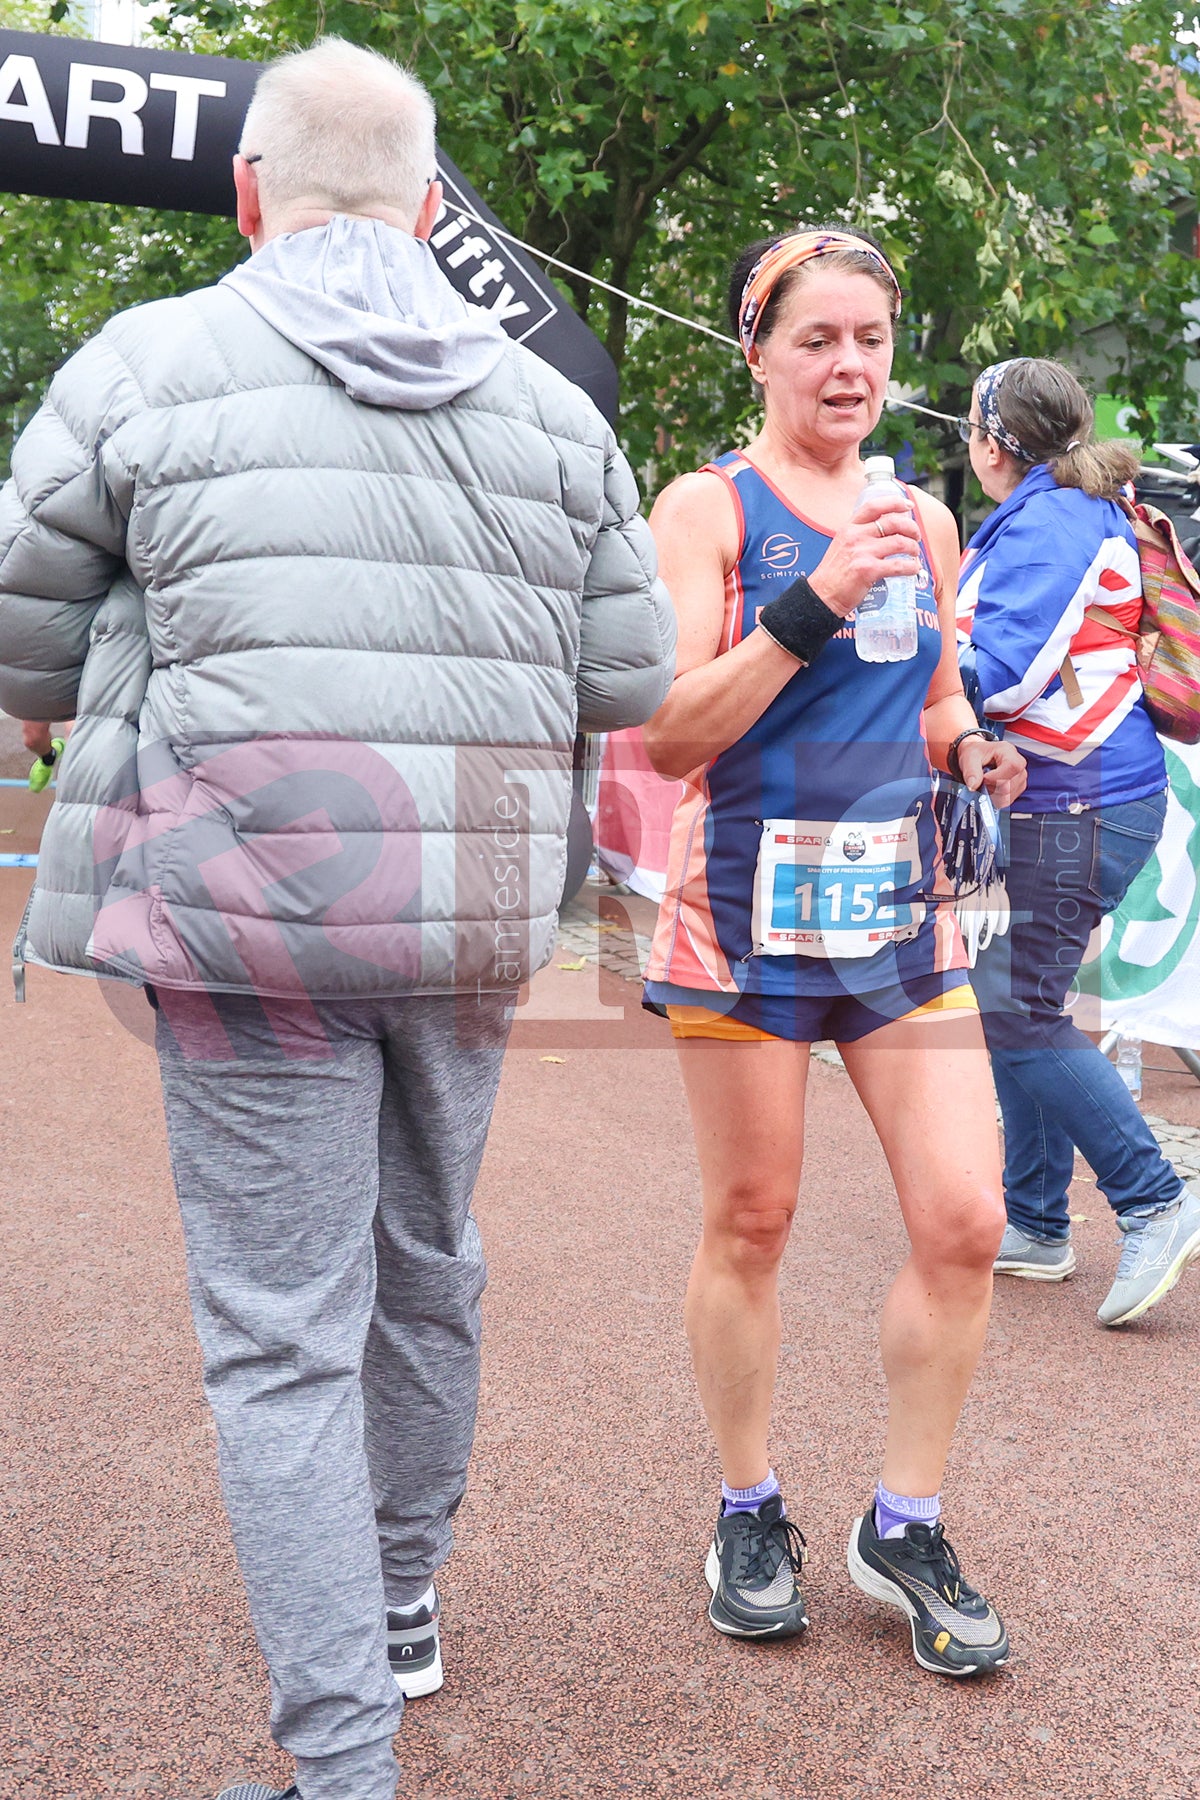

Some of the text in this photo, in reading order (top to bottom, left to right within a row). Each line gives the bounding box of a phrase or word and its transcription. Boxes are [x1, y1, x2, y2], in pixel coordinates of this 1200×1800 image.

[429, 202, 532, 322] ifty
[760, 570, 807, 580] SCIMITAR
[786, 835, 822, 845] SPAR
[880, 833, 908, 843] SPAR
[794, 880, 897, 922] 1152
[778, 933, 814, 943] SPAR
[878, 931, 896, 941] SPA
